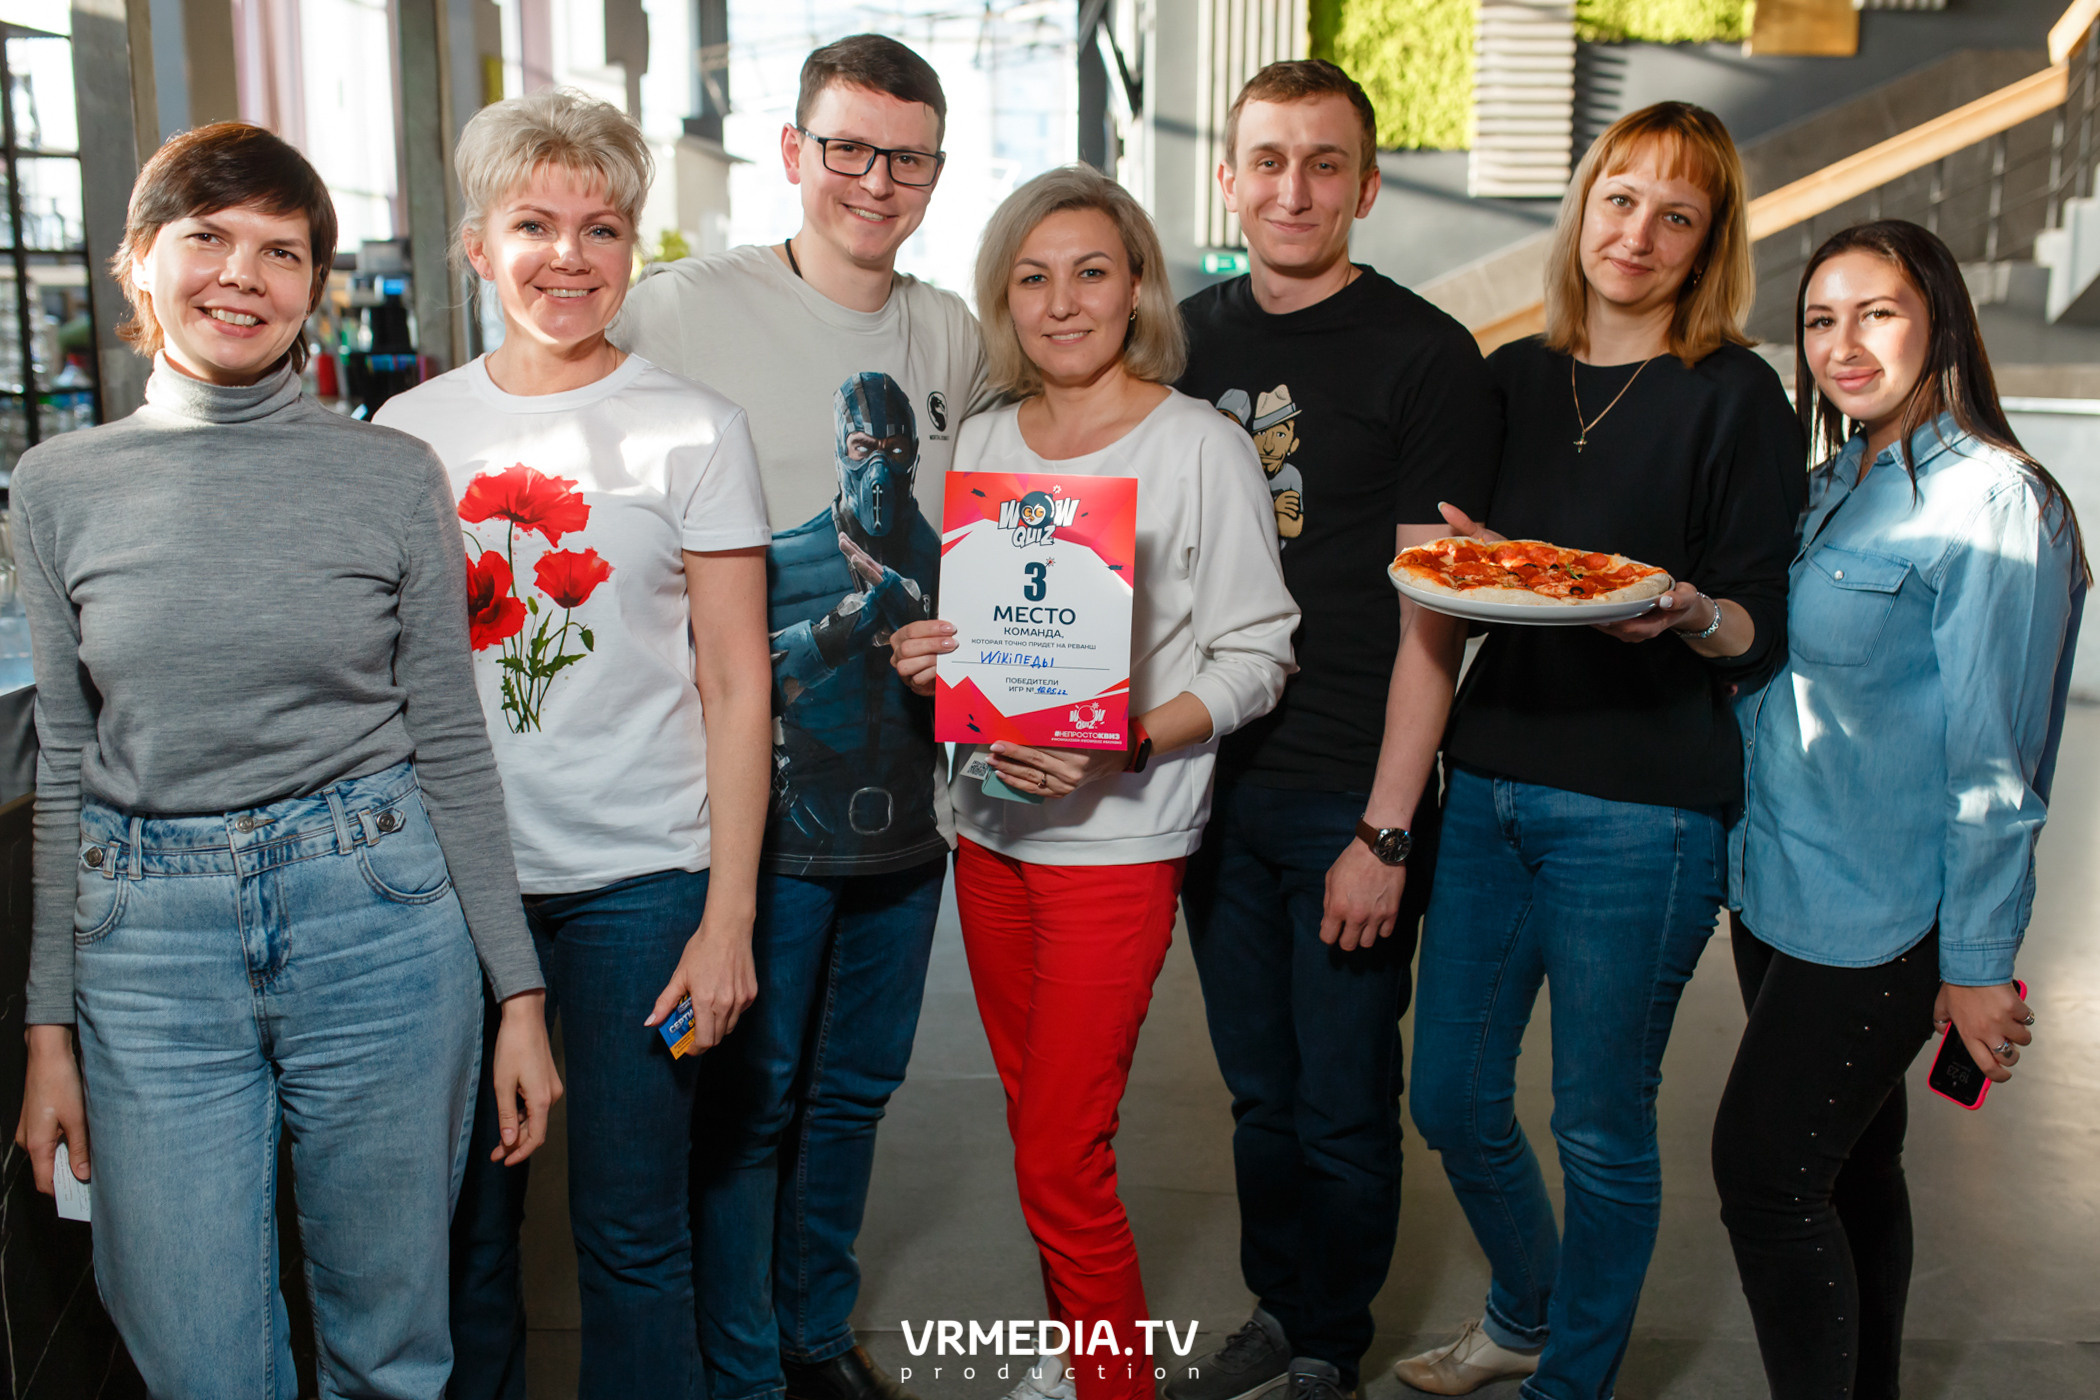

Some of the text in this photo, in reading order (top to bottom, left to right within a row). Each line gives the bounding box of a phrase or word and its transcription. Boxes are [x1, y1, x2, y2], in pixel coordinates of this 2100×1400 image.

[997, 491, 1081, 529] WOW
[1011, 525, 1056, 549] QUIZ
[1024, 562, 1047, 602] 3
[993, 605, 1076, 626] МЕСТО
[971, 638, 1003, 646] КОТОРАЯ
[1028, 641, 1055, 649] ПРИДЕТ
[1003, 627, 1065, 639] КОМАНДА,
[1005, 677, 1059, 686] ПОБЕДИТЕЛИ
